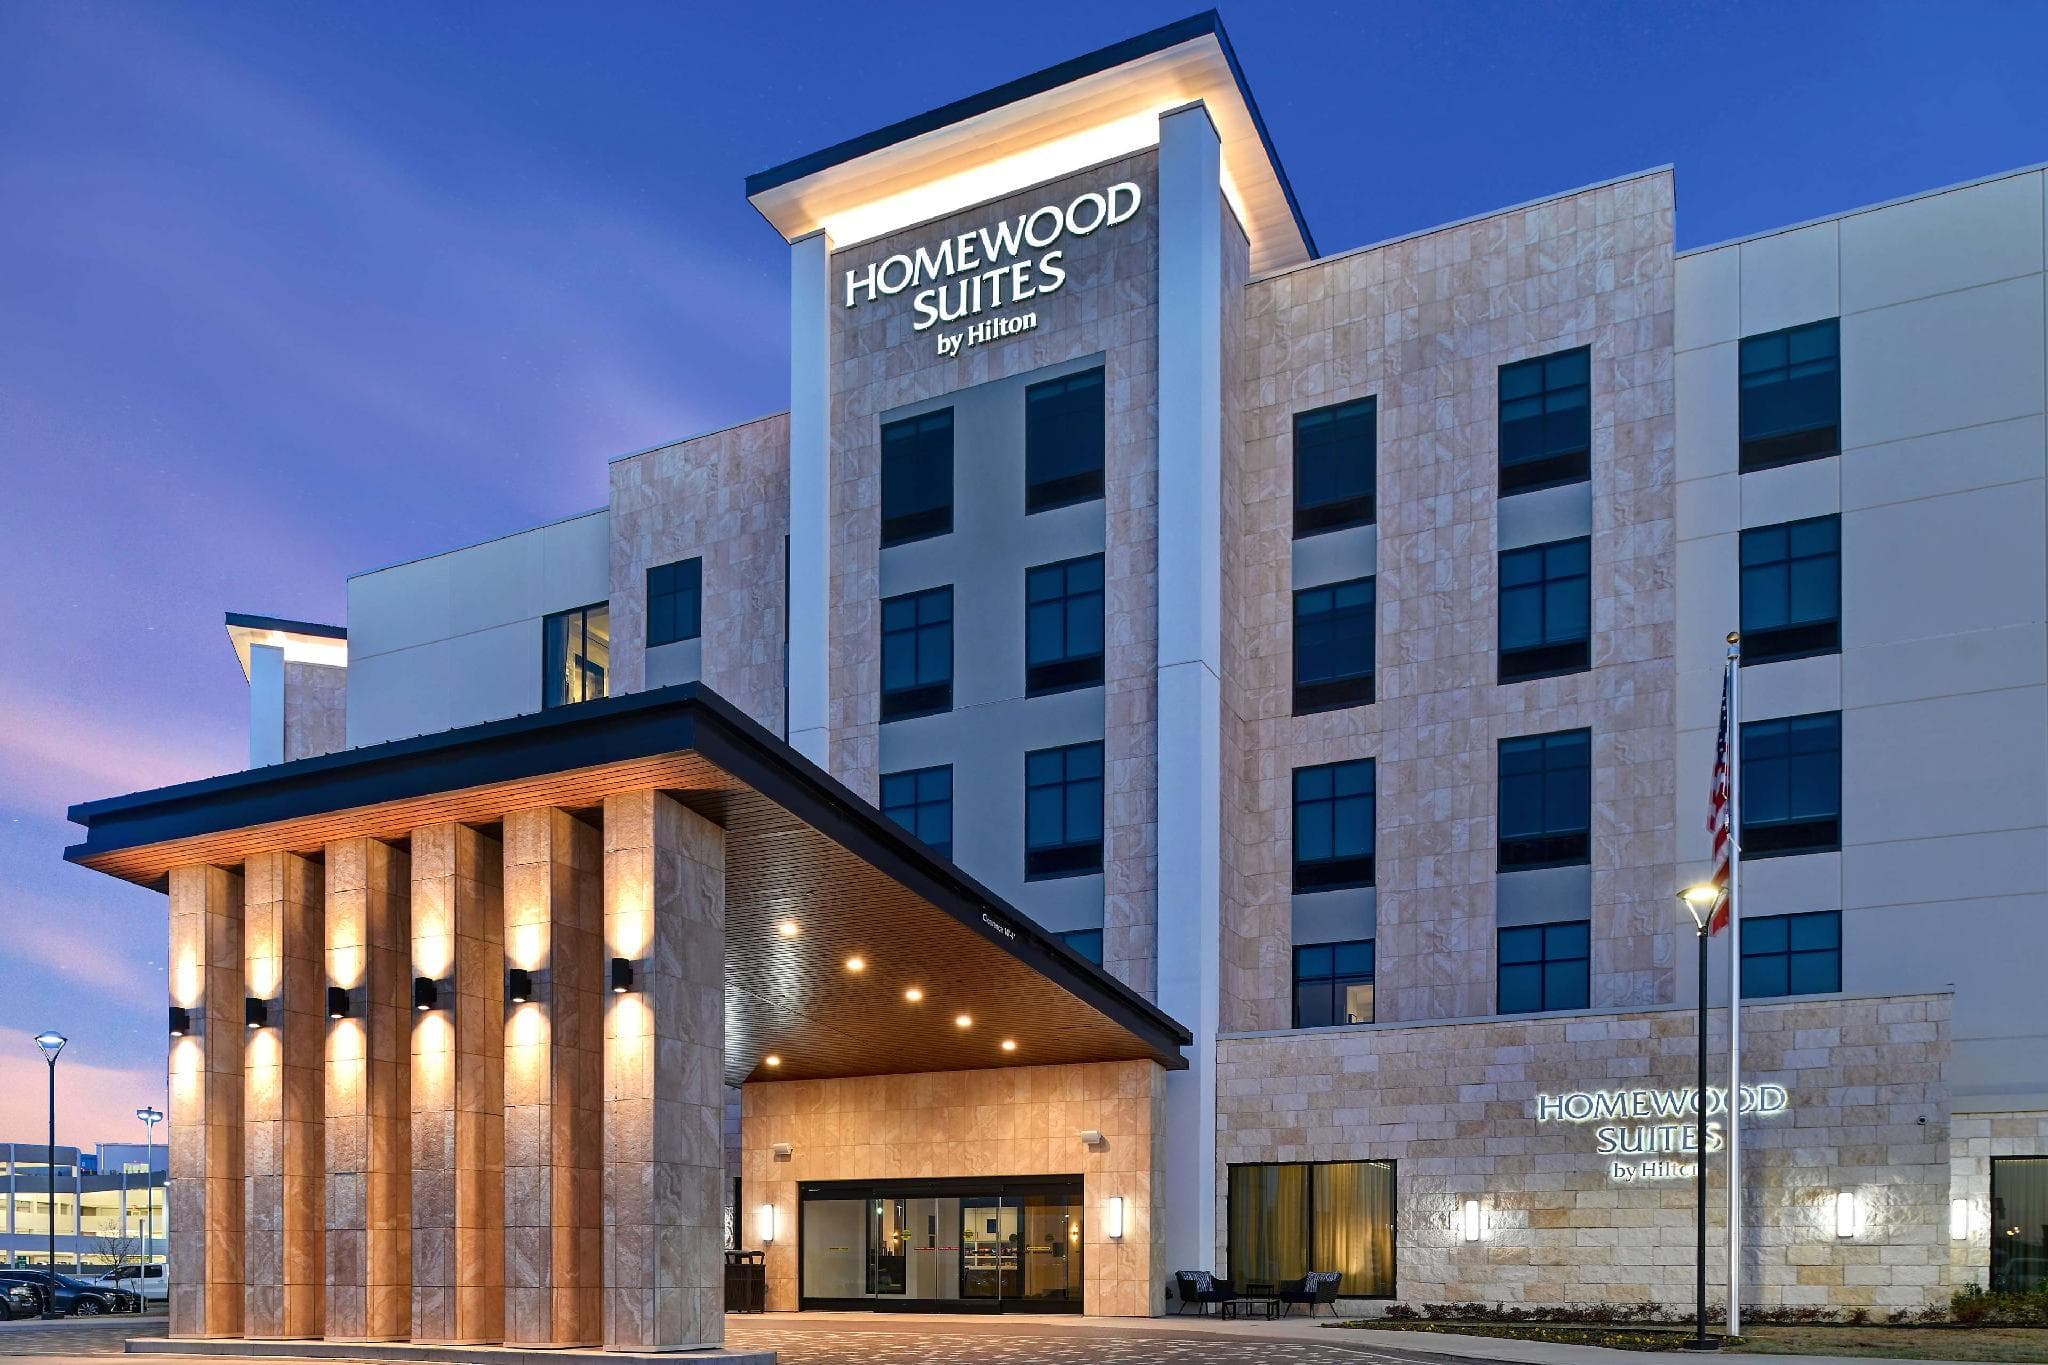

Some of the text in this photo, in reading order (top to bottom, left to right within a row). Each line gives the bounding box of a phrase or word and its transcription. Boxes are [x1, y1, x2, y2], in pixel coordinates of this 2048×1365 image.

[845, 182, 1142, 308] HOMEWOOD
[913, 250, 1067, 331] SUITES
[937, 311, 1038, 357] by Hilton
[1538, 1085, 1788, 1121] HOMEWOOD
[1597, 1123, 1722, 1154] SUITES
[1613, 1162, 1637, 1182] by
